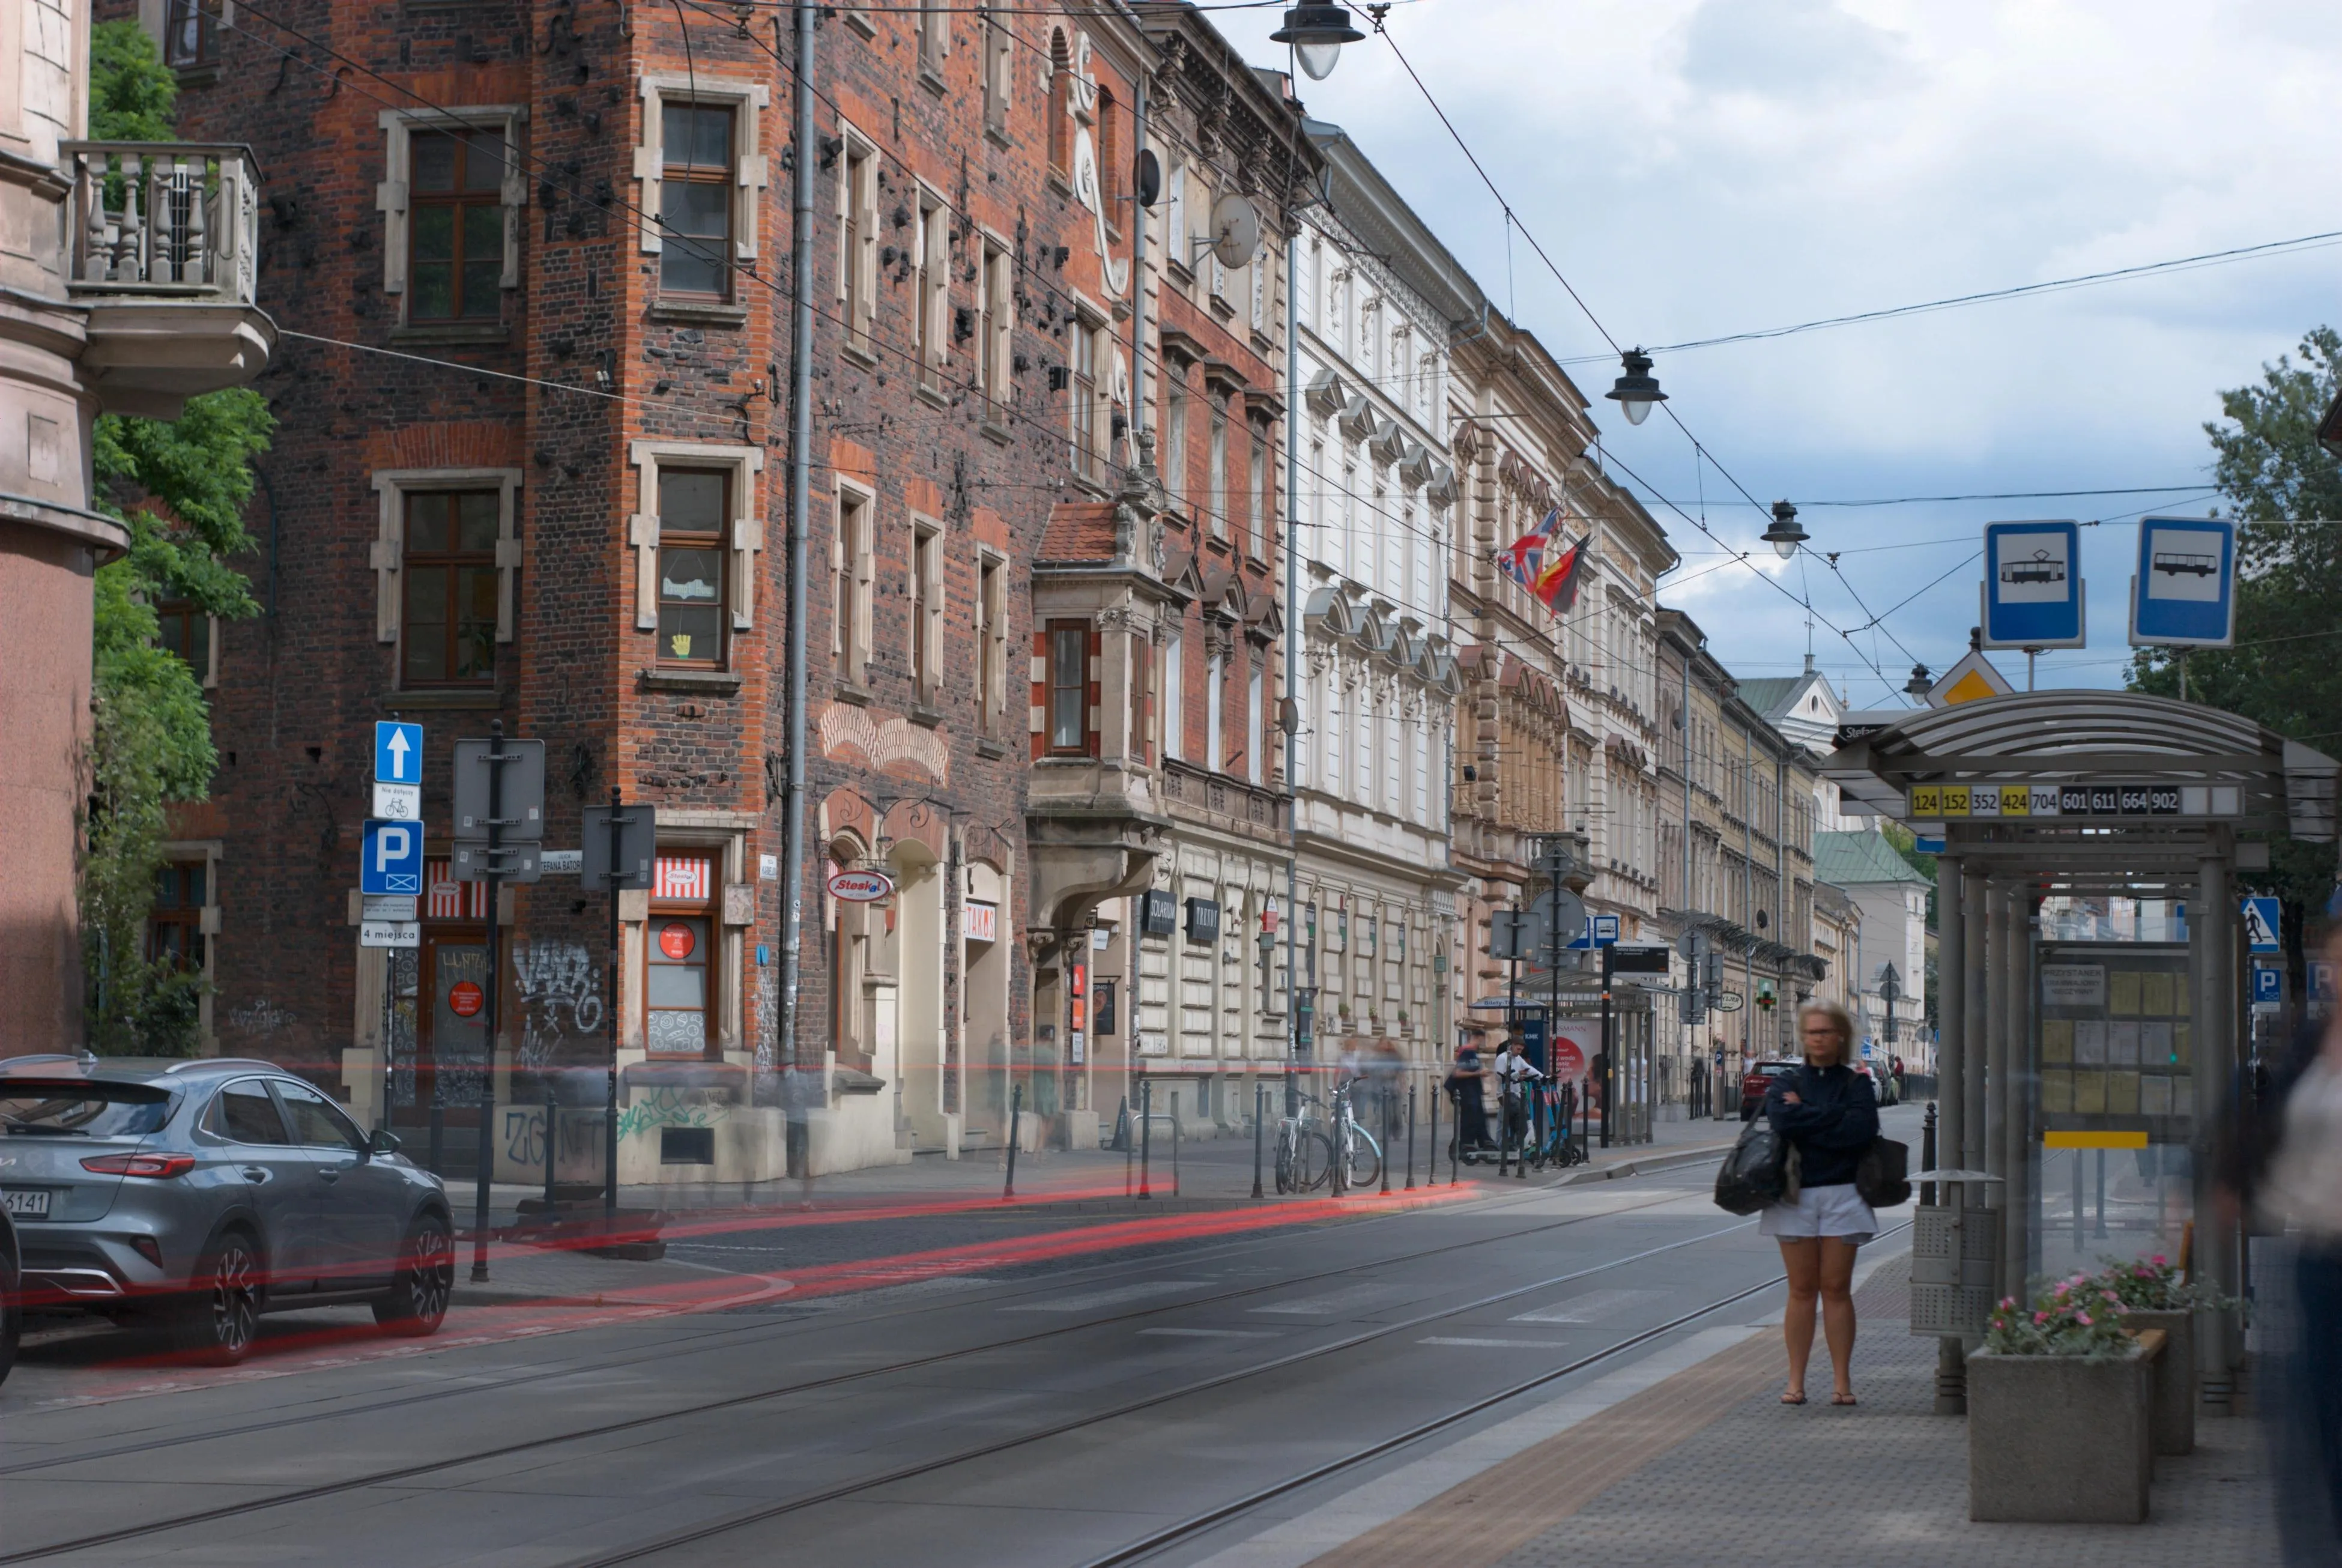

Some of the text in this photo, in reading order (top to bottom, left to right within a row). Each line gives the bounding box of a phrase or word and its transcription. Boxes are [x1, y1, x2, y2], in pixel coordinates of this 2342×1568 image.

[393, 787, 414, 797] dotyczy
[1914, 792, 2178, 810] 124 152 352 424 704 601 611 664 902
[377, 827, 410, 873] P
[540, 861, 561, 872] TEFANA
[834, 879, 882, 893] Steskal
[1151, 898, 1175, 919] SOLARIUM
[1196, 906, 1218, 928] TRENDY
[363, 929, 415, 941] 4 miejsca
[2260, 971, 2276, 992] P
